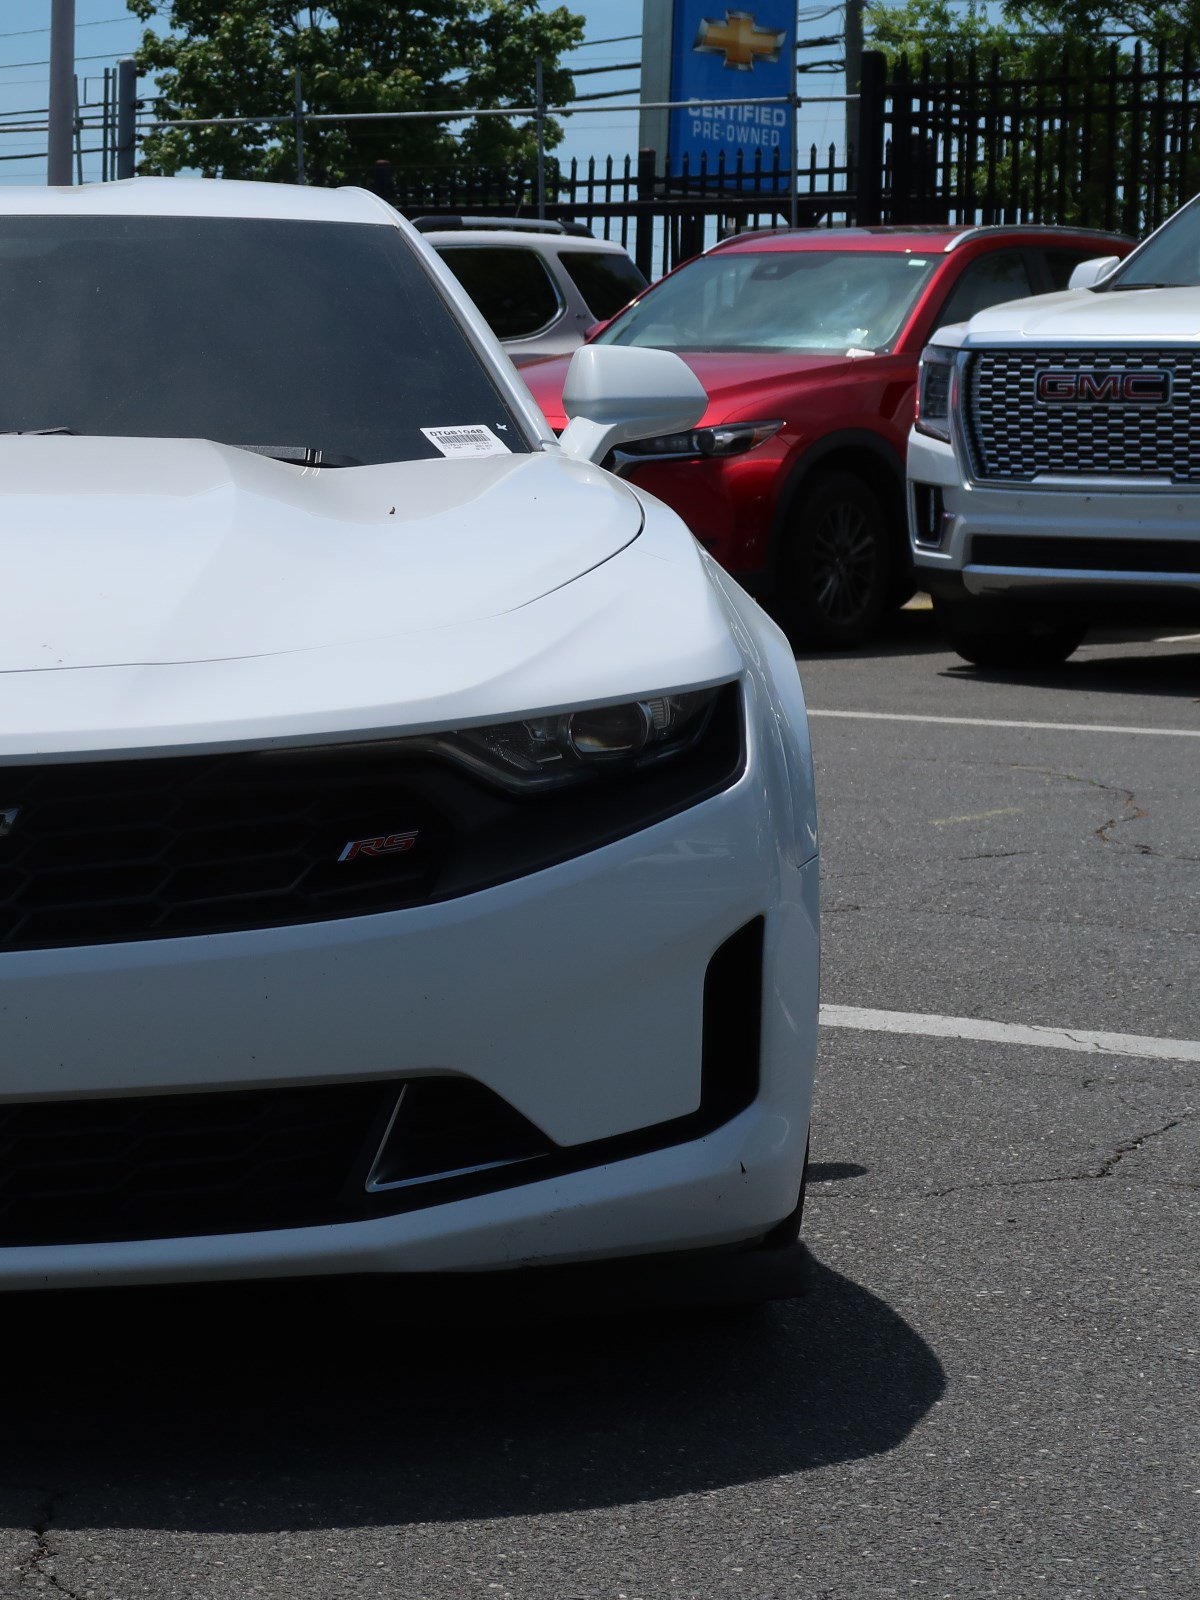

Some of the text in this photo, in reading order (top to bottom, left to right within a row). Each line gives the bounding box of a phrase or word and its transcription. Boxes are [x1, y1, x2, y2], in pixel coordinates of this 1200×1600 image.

[688, 97, 787, 127] CERTIFIED
[693, 120, 780, 147] PRE-OWNED
[1039, 373, 1165, 401] GMC
[338, 829, 419, 862] RS
